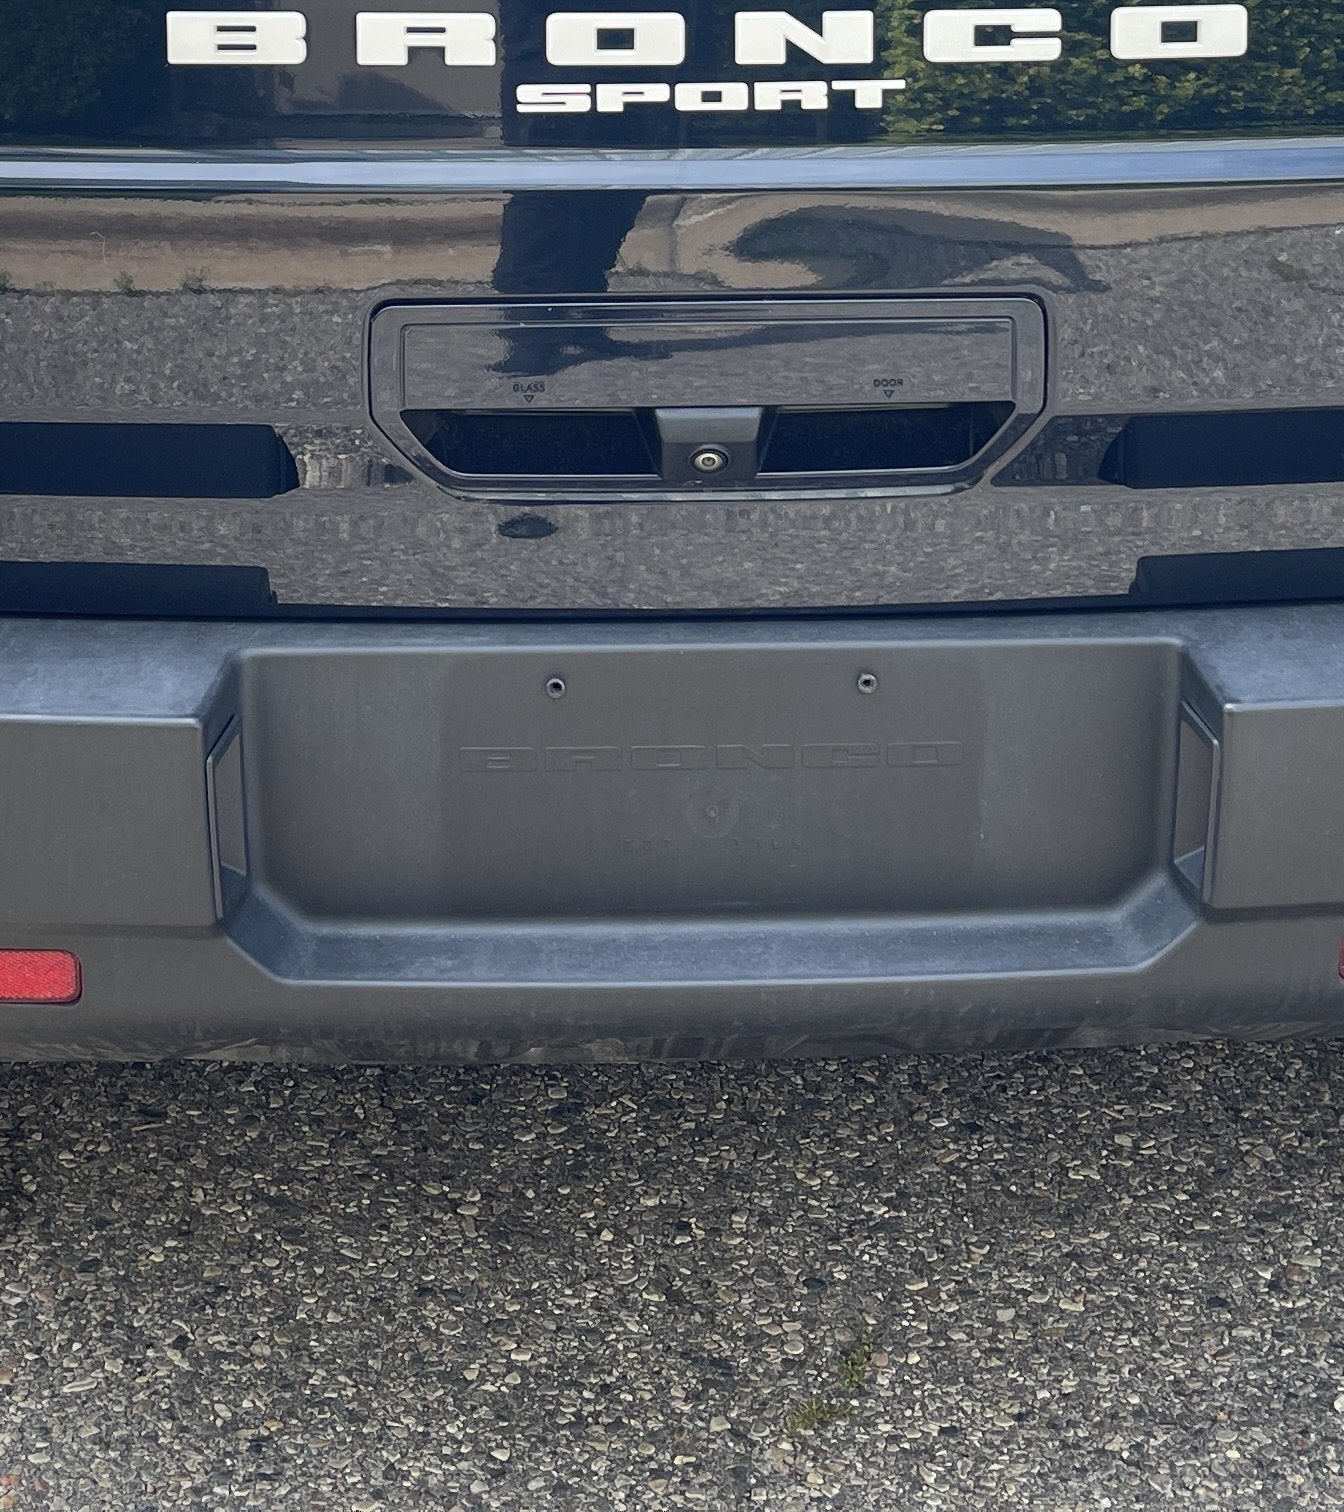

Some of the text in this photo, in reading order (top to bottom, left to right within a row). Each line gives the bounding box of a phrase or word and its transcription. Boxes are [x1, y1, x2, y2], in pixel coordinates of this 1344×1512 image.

[166, 4, 1249, 66] BRONCO
[516, 79, 906, 113] SPORT
[512, 383, 545, 393] GLASS
[873, 378, 904, 387] DOOR
[459, 740, 964, 773] BRONCO
